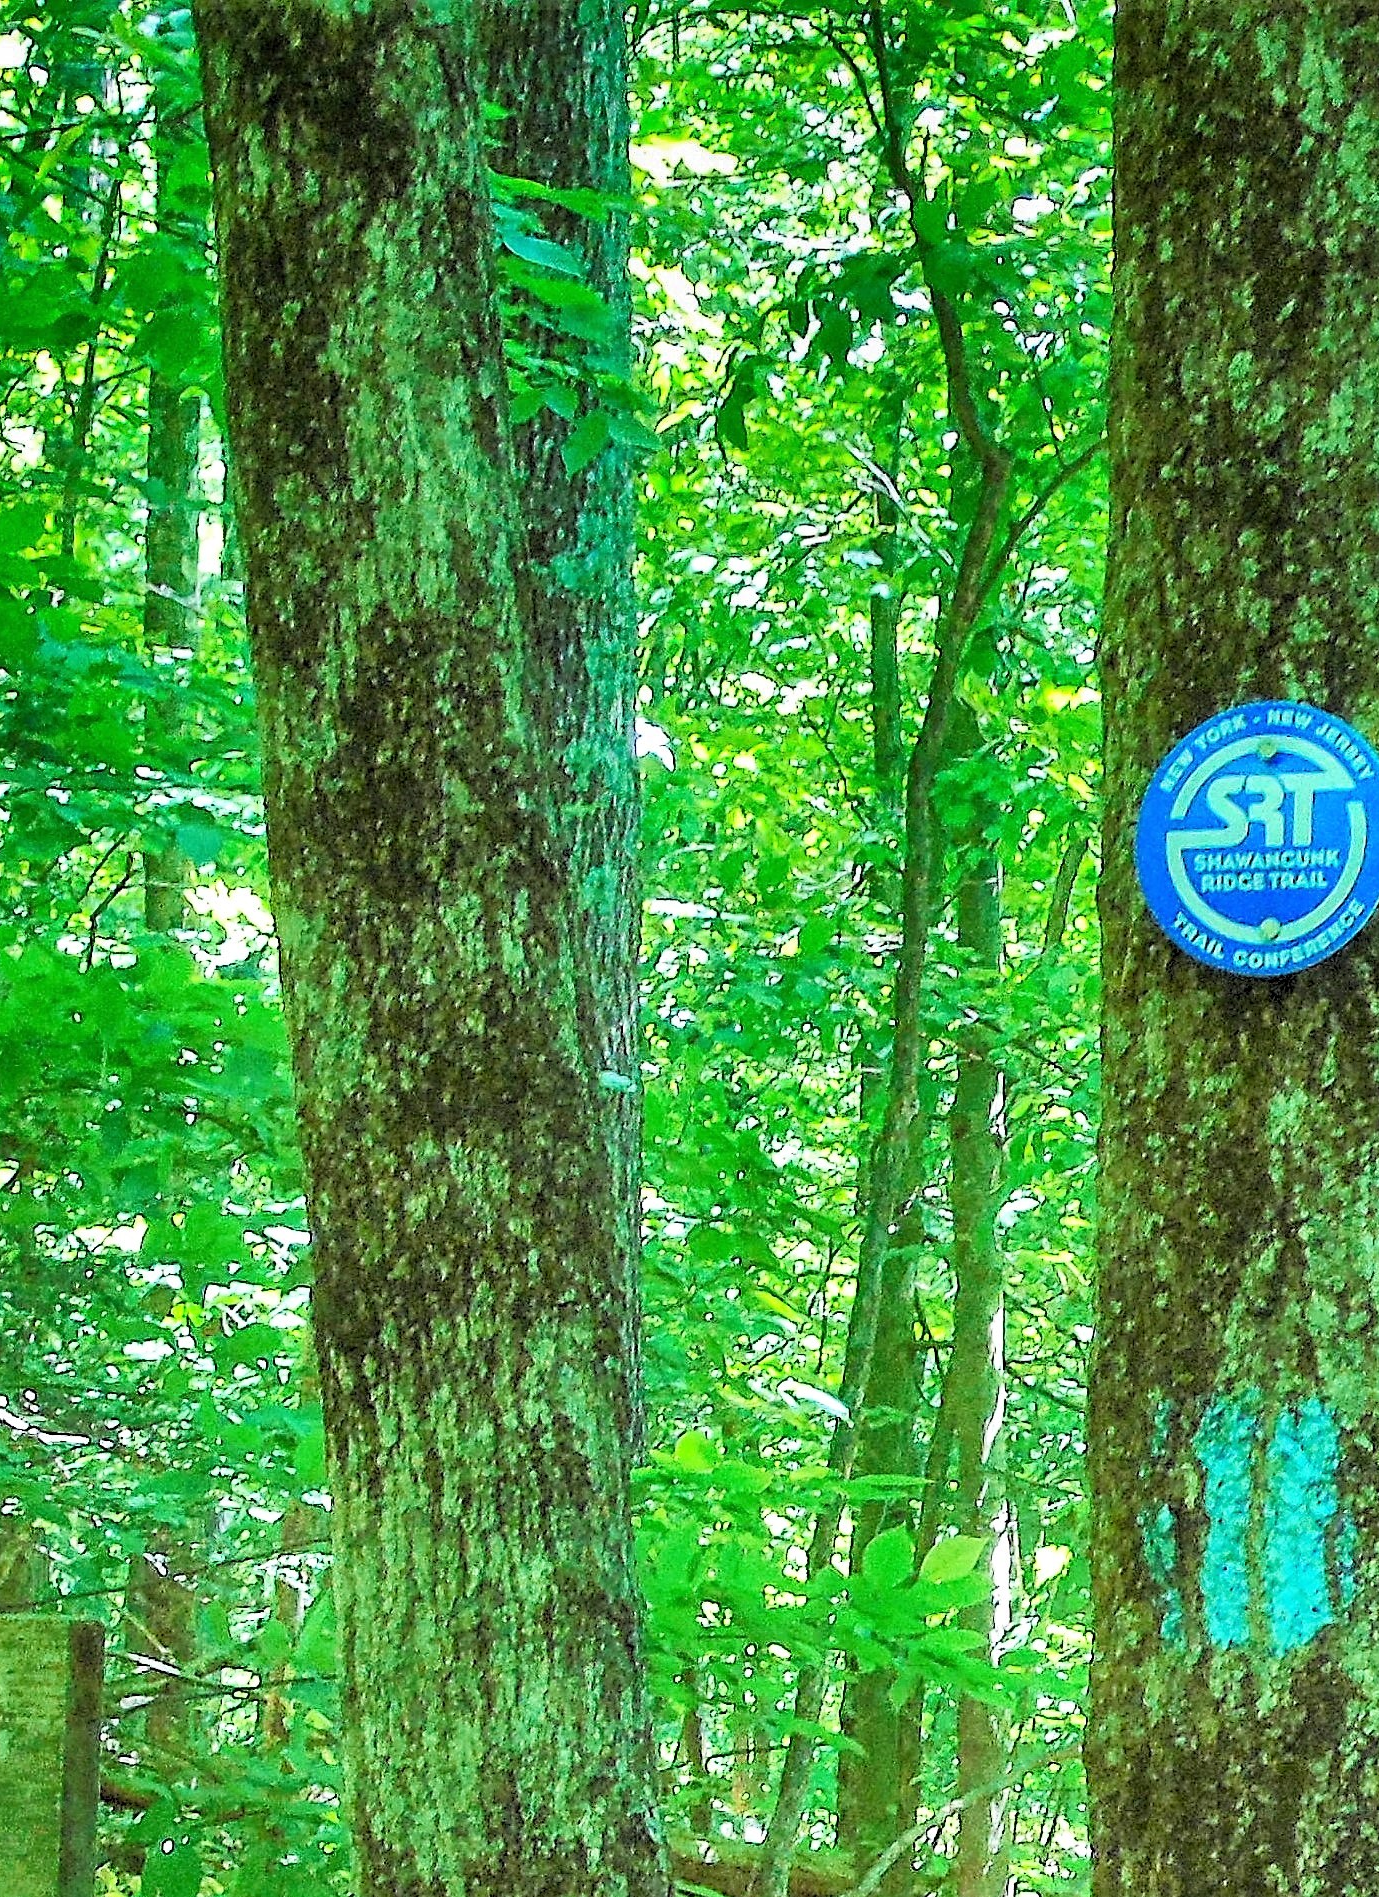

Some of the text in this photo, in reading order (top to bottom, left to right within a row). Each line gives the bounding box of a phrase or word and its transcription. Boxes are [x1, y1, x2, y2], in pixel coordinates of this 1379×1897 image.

[1159, 749, 1194, 793] NEW
[1192, 713, 1248, 750] YORK
[1267, 709, 1313, 730] NEW
[1315, 722, 1374, 781] JERSEY
[1186, 770, 1353, 848] SRT
[1193, 849, 1340, 872] SHAWANGUNK
[1201, 870, 1328, 893] RIDGE TRAIL
[1173, 899, 1366, 969] TRAIL CONFERENCE
